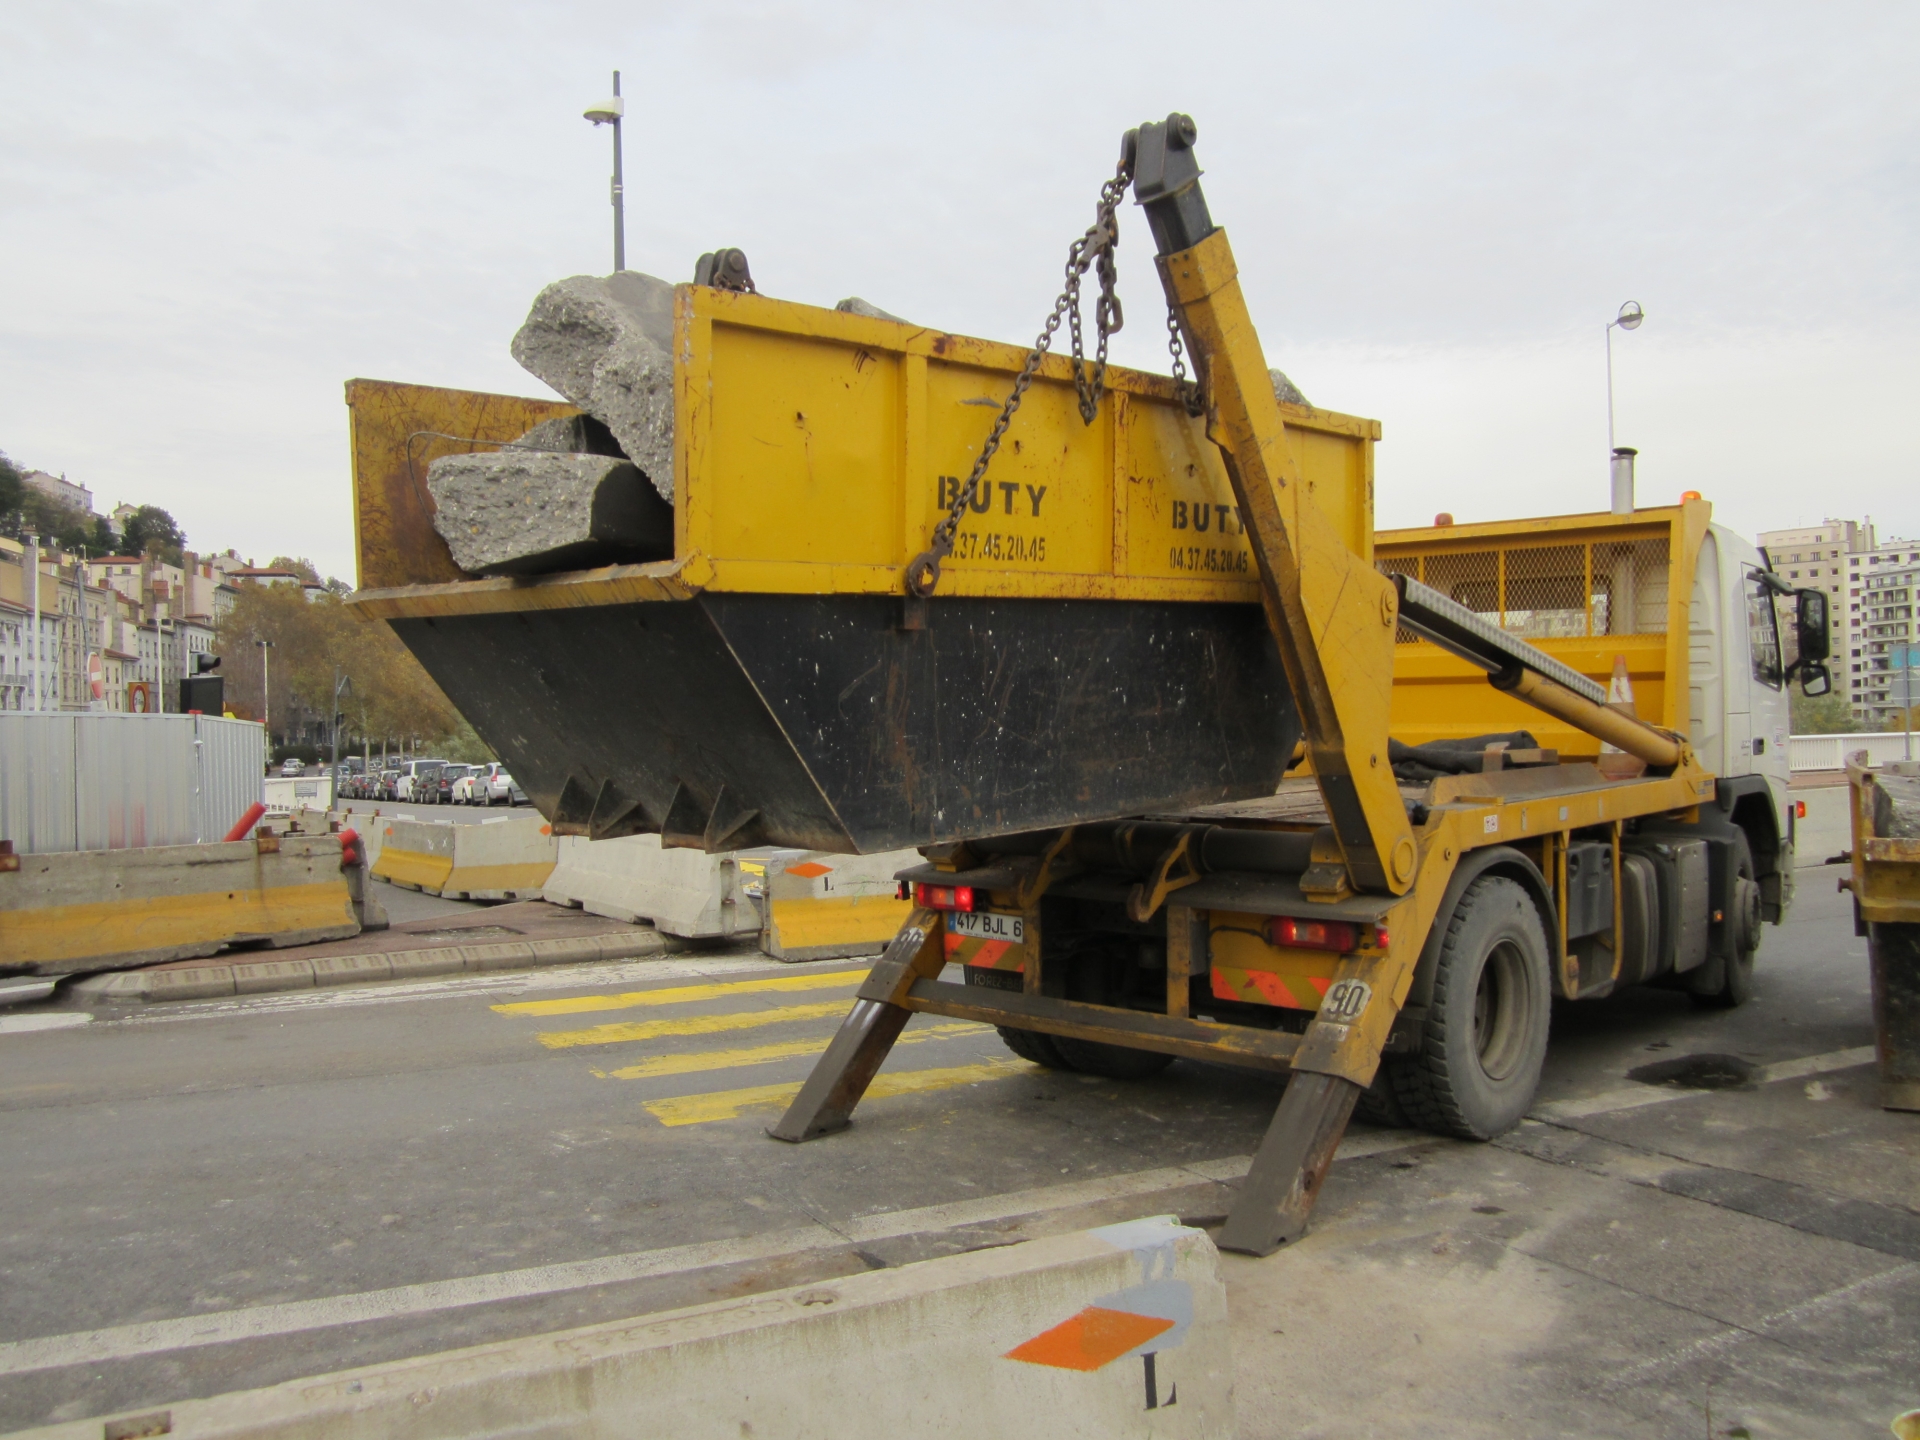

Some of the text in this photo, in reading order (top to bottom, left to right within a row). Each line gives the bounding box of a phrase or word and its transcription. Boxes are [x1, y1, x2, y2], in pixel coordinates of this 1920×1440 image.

[938, 475, 1047, 517] BUTY
[948, 532, 1046, 562] .37.45.20.45
[1170, 546, 1248, 574] 04.37.45.20.45
[957, 912, 978, 931] 417
[983, 916, 1008, 936] BJL
[1326, 983, 1365, 1017] 90
